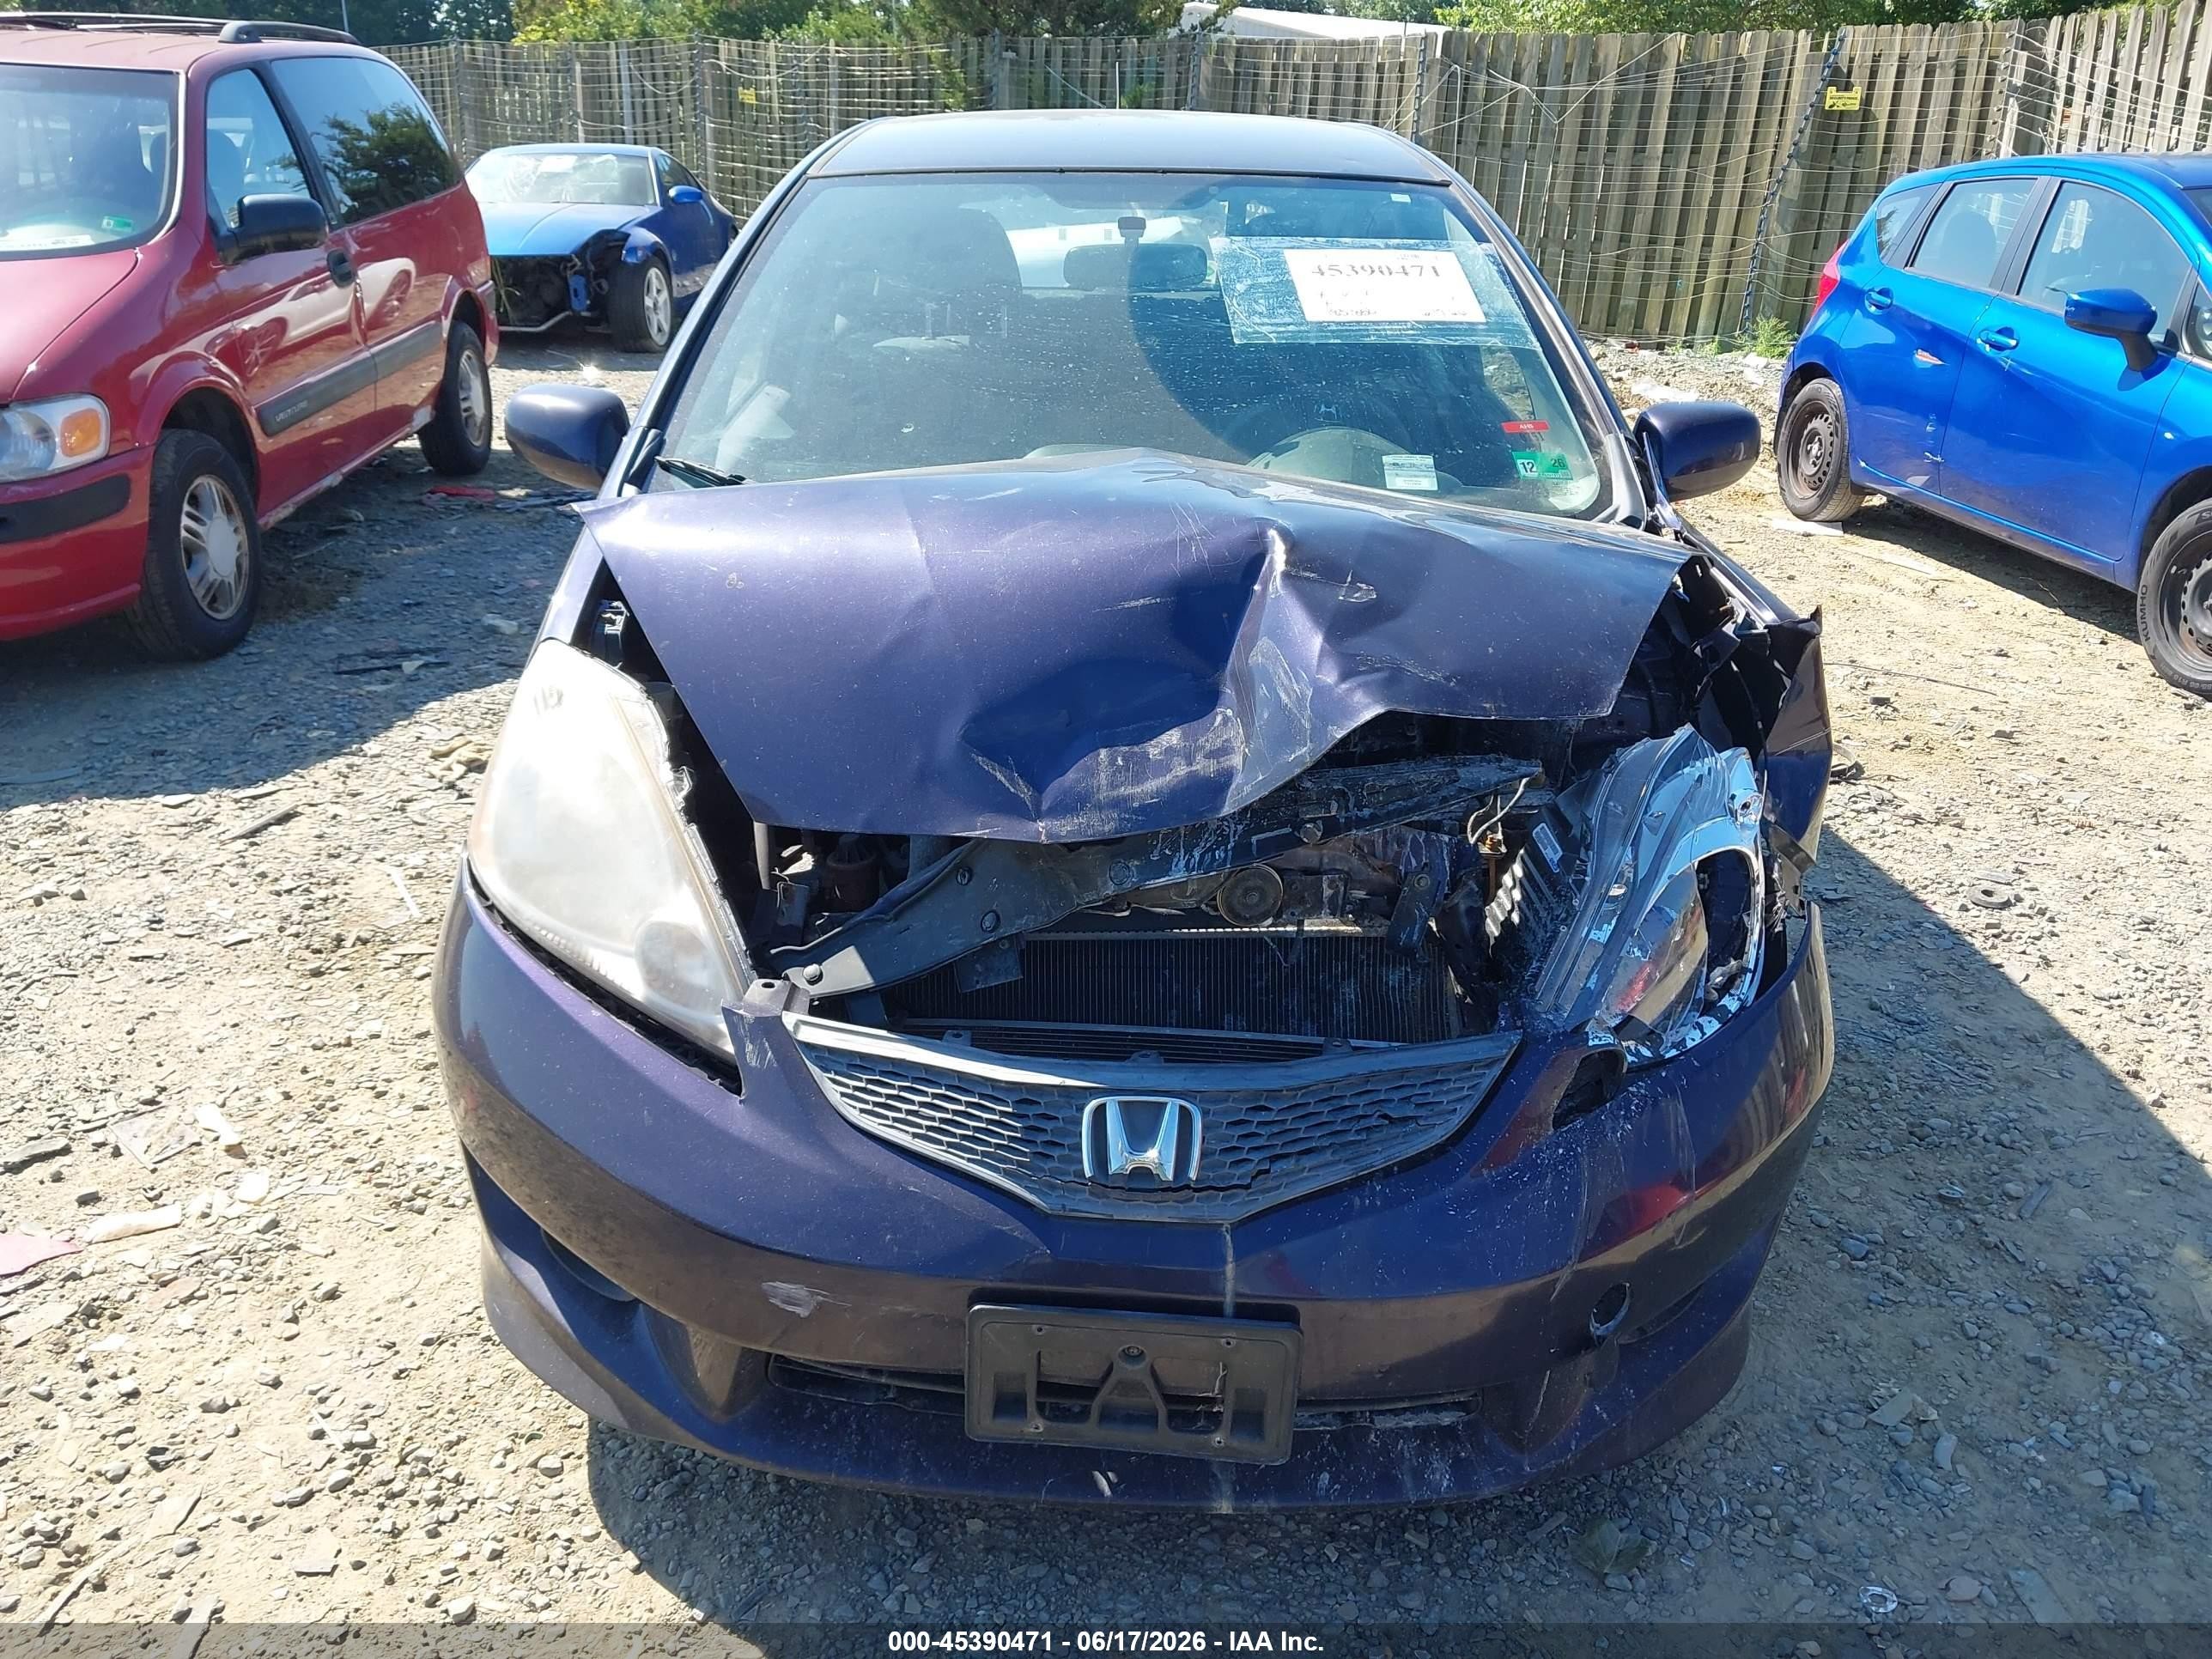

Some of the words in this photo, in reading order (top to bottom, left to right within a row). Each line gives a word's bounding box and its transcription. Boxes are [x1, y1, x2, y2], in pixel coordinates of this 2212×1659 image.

[1311, 264, 1441, 277] 45390471
[1519, 461, 1539, 473] 12
[1551, 458, 1566, 468] 26
[2139, 584, 2151, 642] KUMHO
